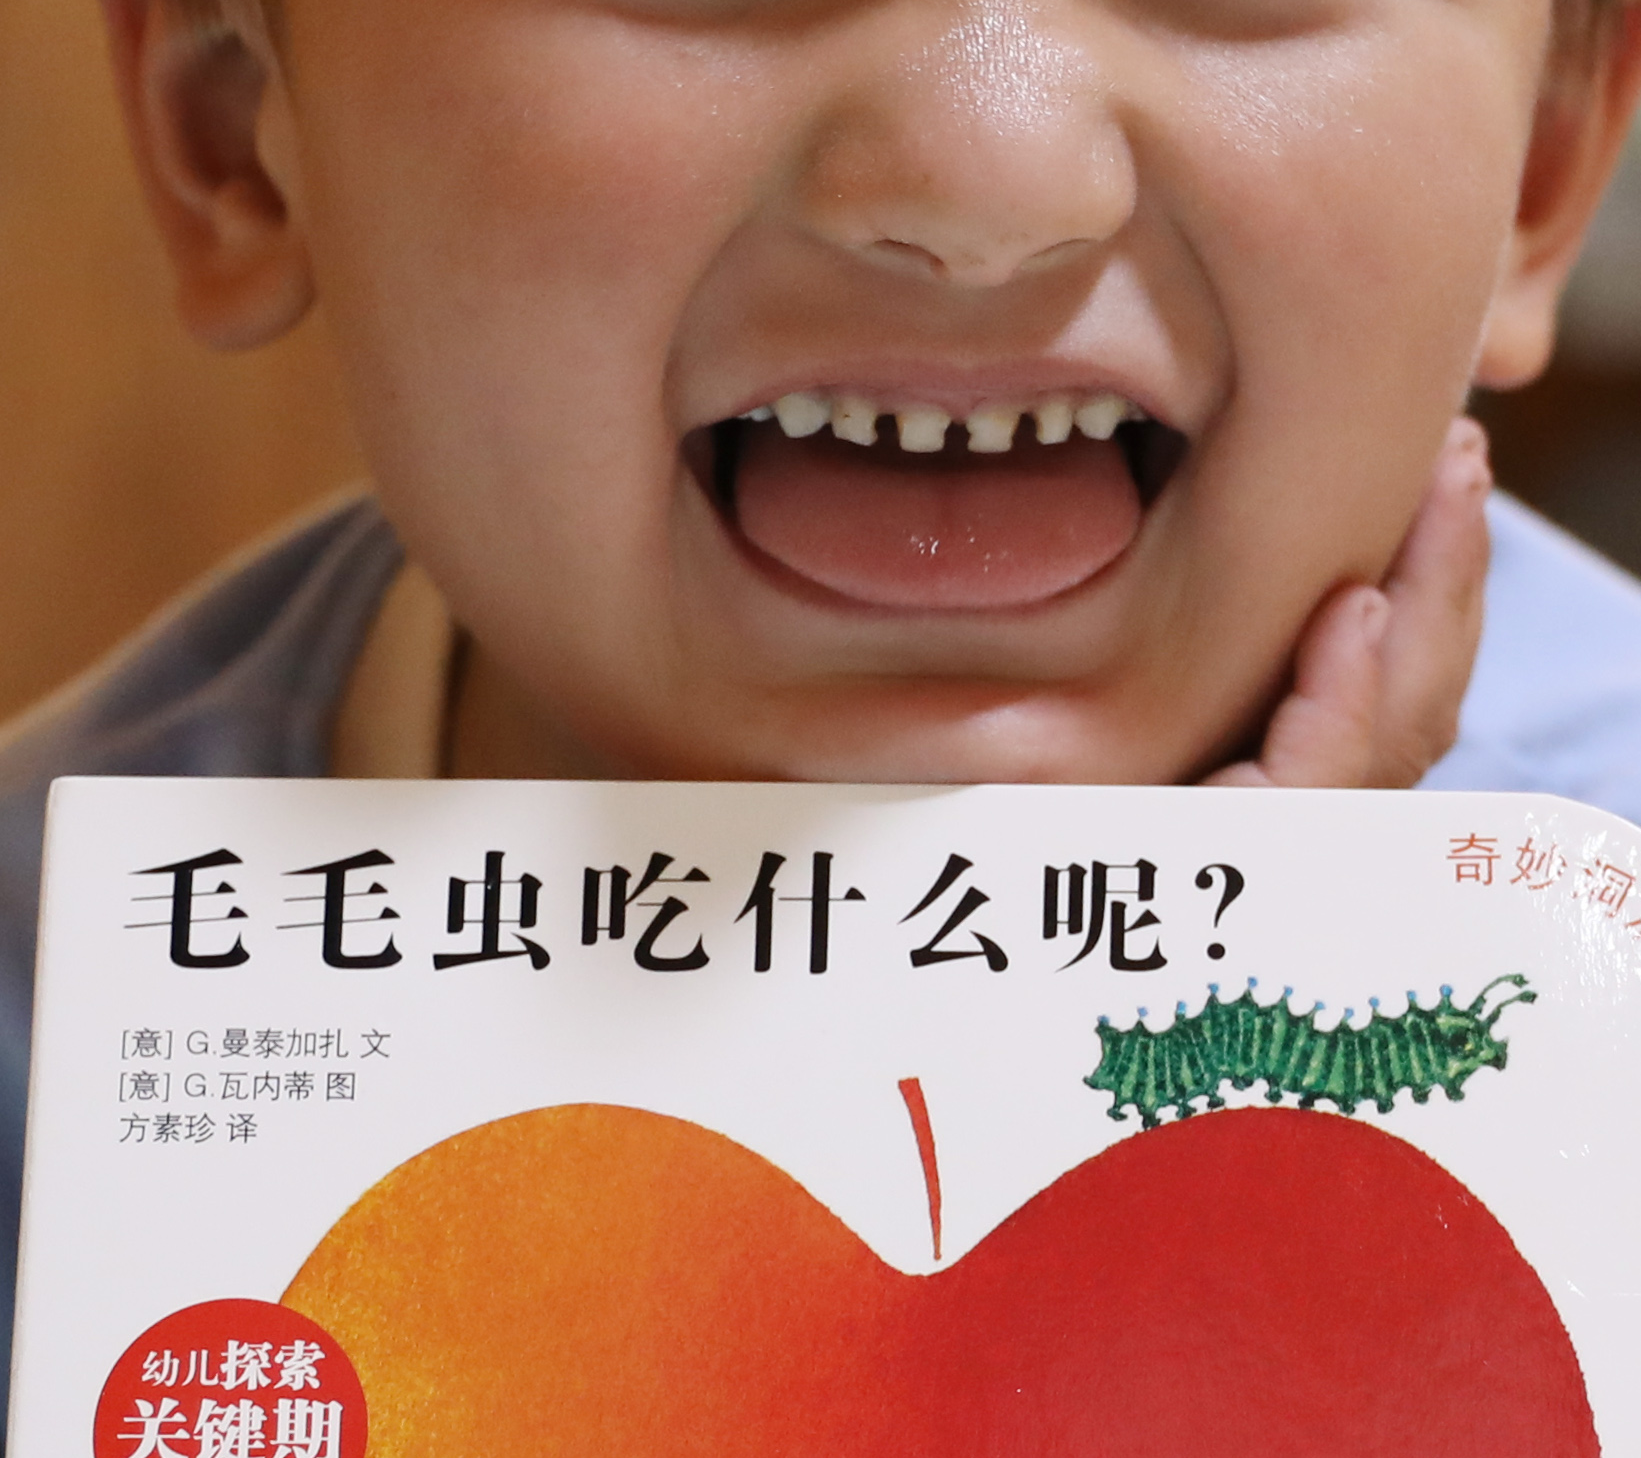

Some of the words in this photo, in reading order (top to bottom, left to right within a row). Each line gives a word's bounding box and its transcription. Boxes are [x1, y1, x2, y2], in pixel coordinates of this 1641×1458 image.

[120, 1027, 173, 1060] [意]
[186, 1027, 349, 1060] G.曼泰加扎
[360, 1027, 392, 1059] 文
[118, 1070, 171, 1102] [意]
[183, 1070, 315, 1102] G.瓦内蒂
[325, 1071, 357, 1101] 图
[119, 1111, 217, 1144] 方素珍
[226, 1112, 259, 1144] 译
[140, 1339, 326, 1391] 幼儿探索
